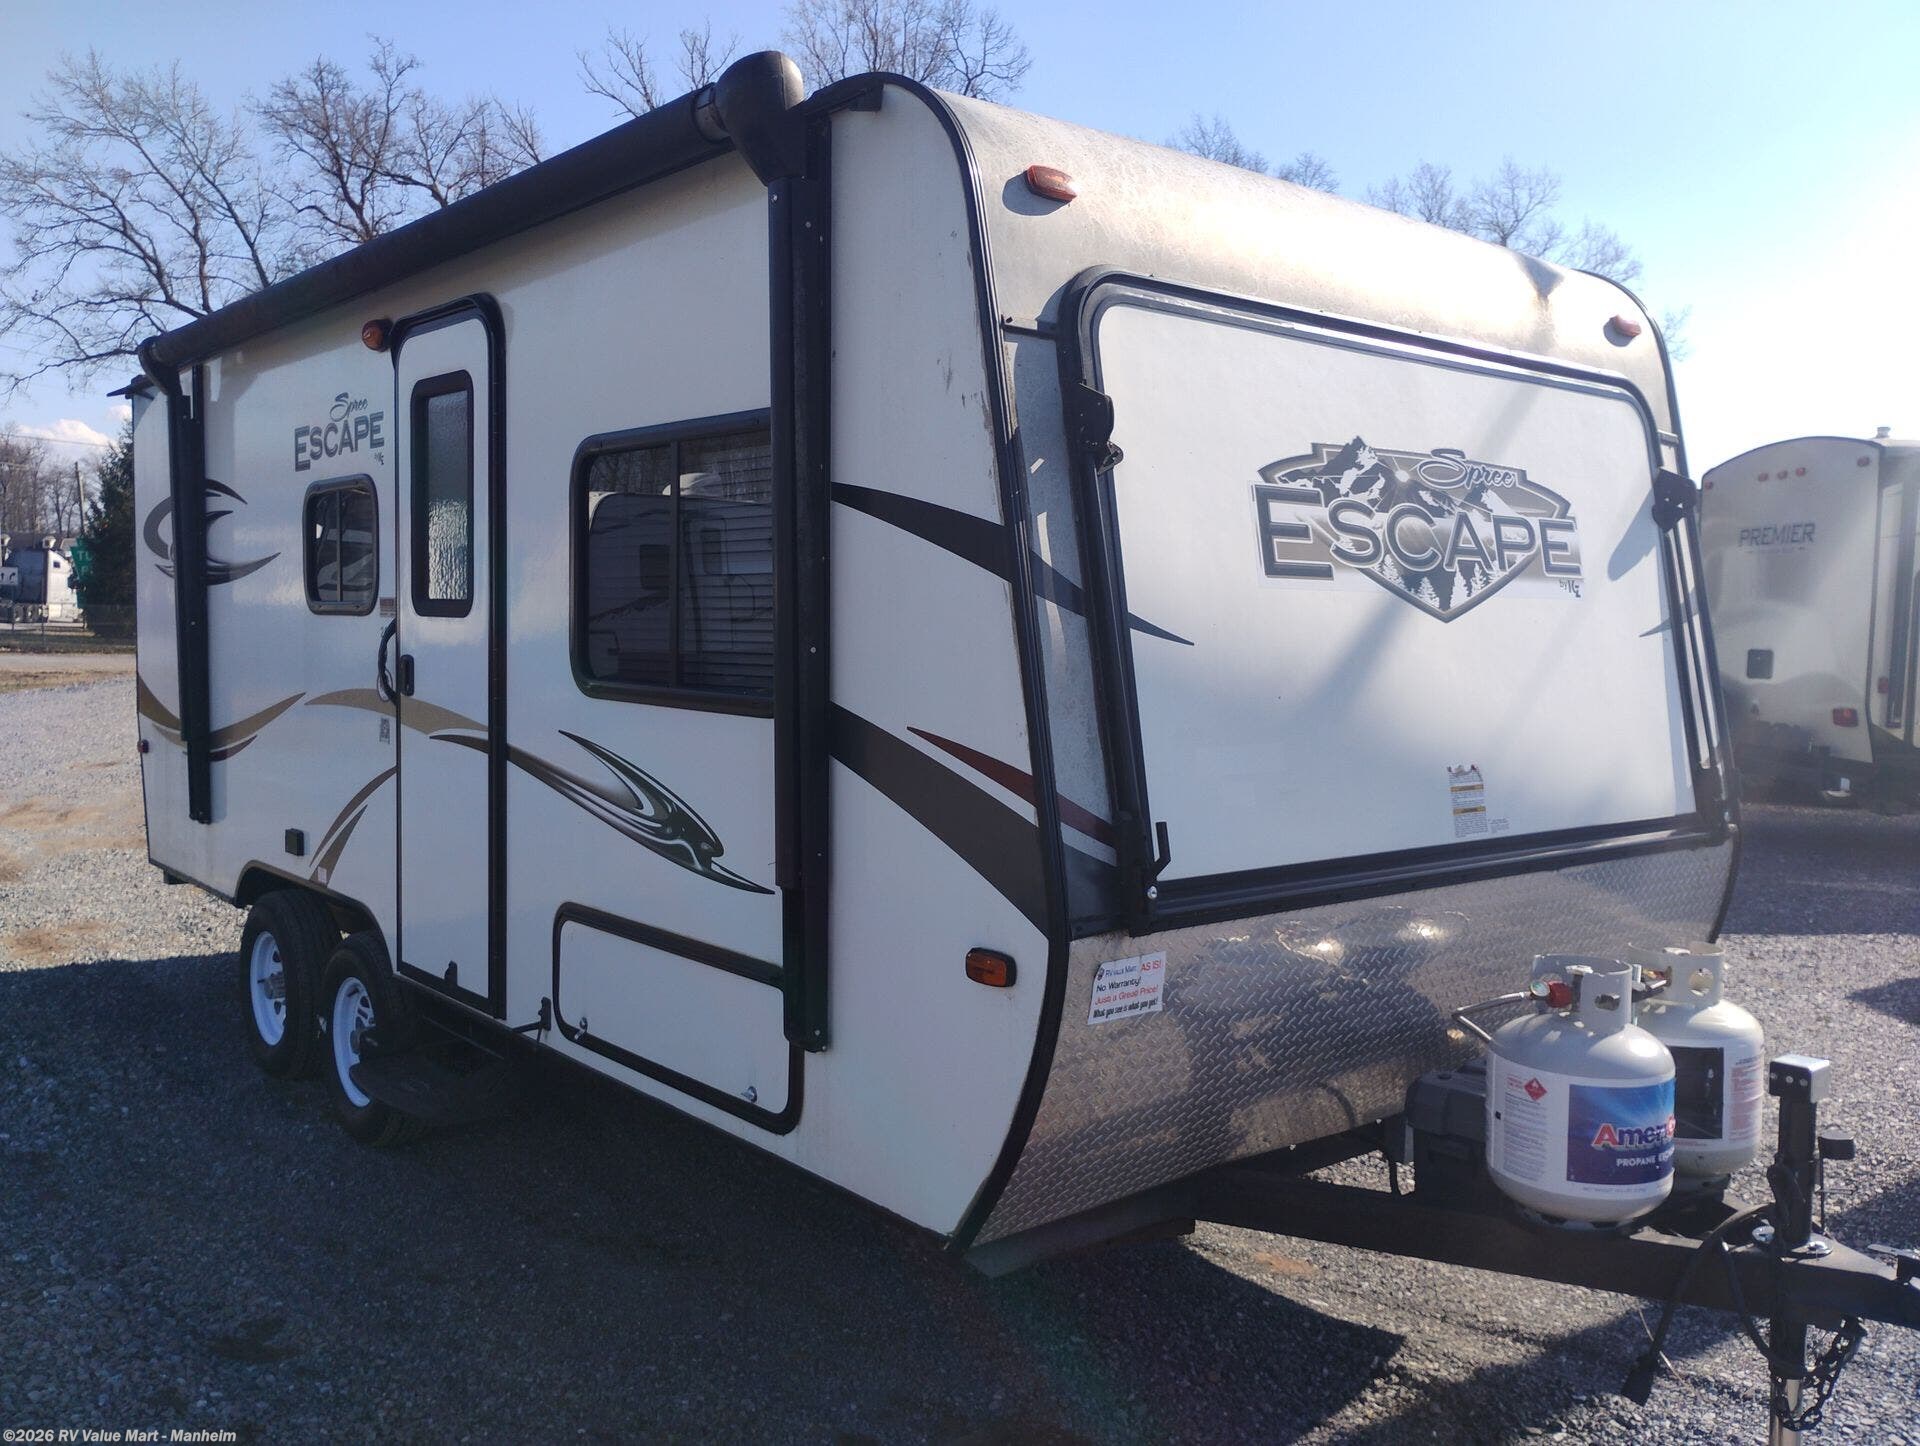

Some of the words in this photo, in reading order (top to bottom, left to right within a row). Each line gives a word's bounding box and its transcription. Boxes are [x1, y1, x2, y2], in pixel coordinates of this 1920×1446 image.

[329, 392, 368, 422] Spree
[294, 411, 385, 472] ESCAPE
[1418, 449, 1516, 488] Spree
[1252, 484, 1582, 580] ESCAPE
[1739, 523, 1816, 547] PREMIER
[1141, 962, 1151, 971] AS
[1152, 960, 1163, 969] IS!
[1108, 976, 1142, 989] Warranty!
[1095, 996, 1112, 1006] Just
[1118, 990, 1139, 1001] Great
[1139, 984, 1159, 995] Price!
[1616, 1155, 1656, 1168] PROPANE
